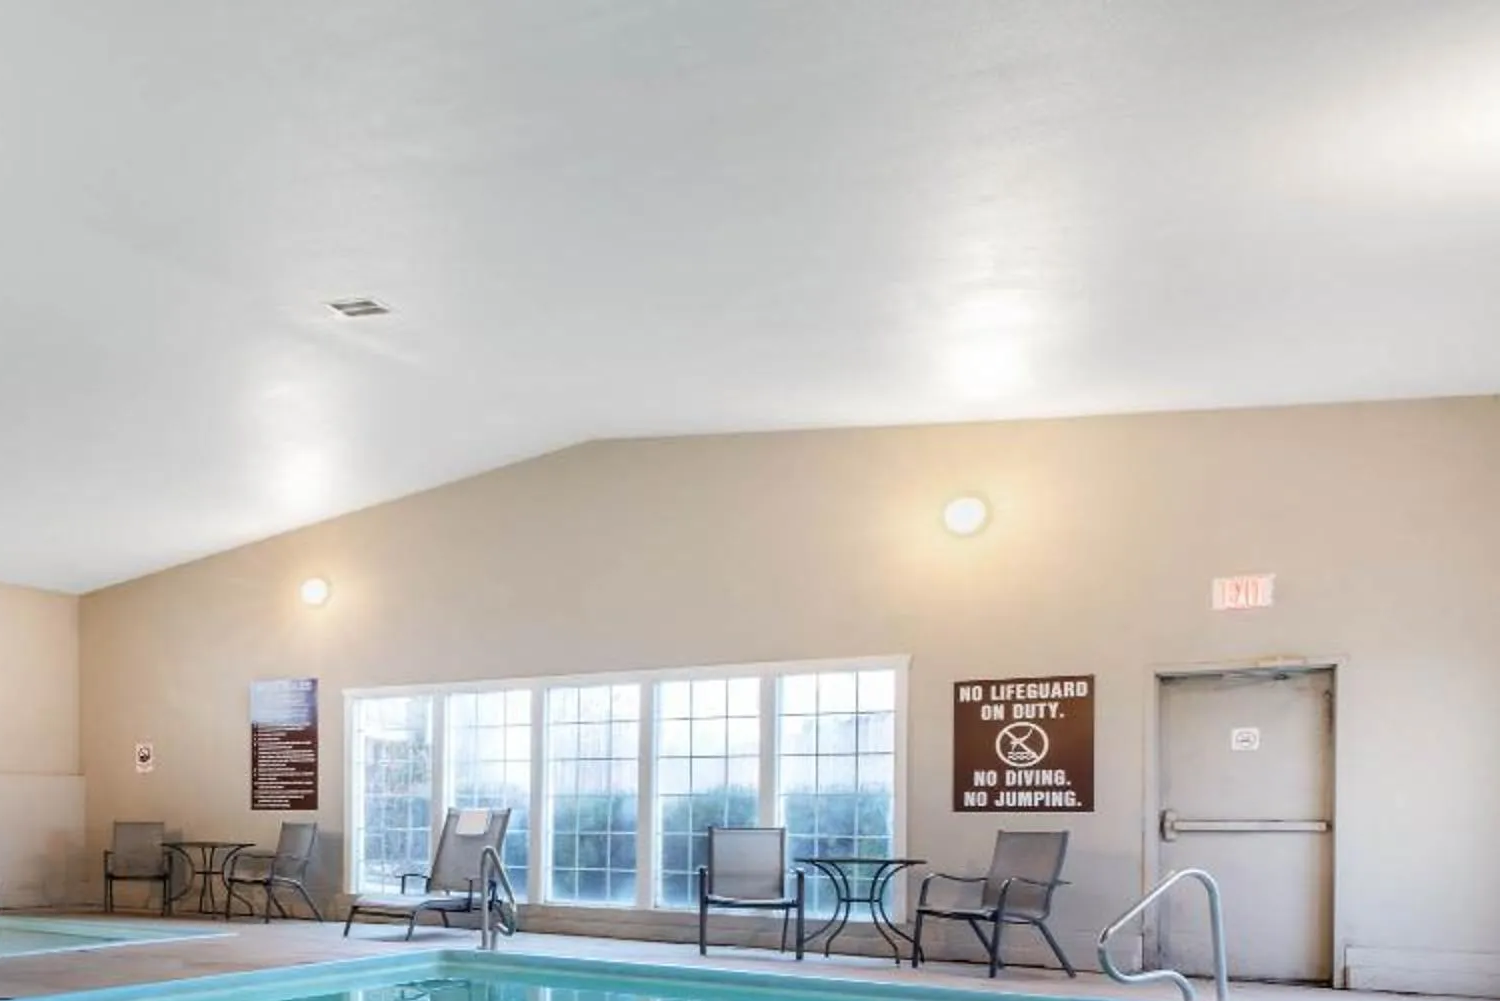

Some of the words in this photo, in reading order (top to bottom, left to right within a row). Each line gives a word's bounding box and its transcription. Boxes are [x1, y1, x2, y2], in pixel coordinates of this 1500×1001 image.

[959, 686, 983, 702] NO
[991, 681, 1088, 701] LIFEGUARD
[981, 705, 1004, 720] ON
[1013, 702, 1065, 719] DUTY.
[974, 770, 997, 787] NO
[1005, 769, 1072, 787] DIVING.
[964, 791, 988, 807] NO
[994, 791, 1082, 807] JUMPING.
